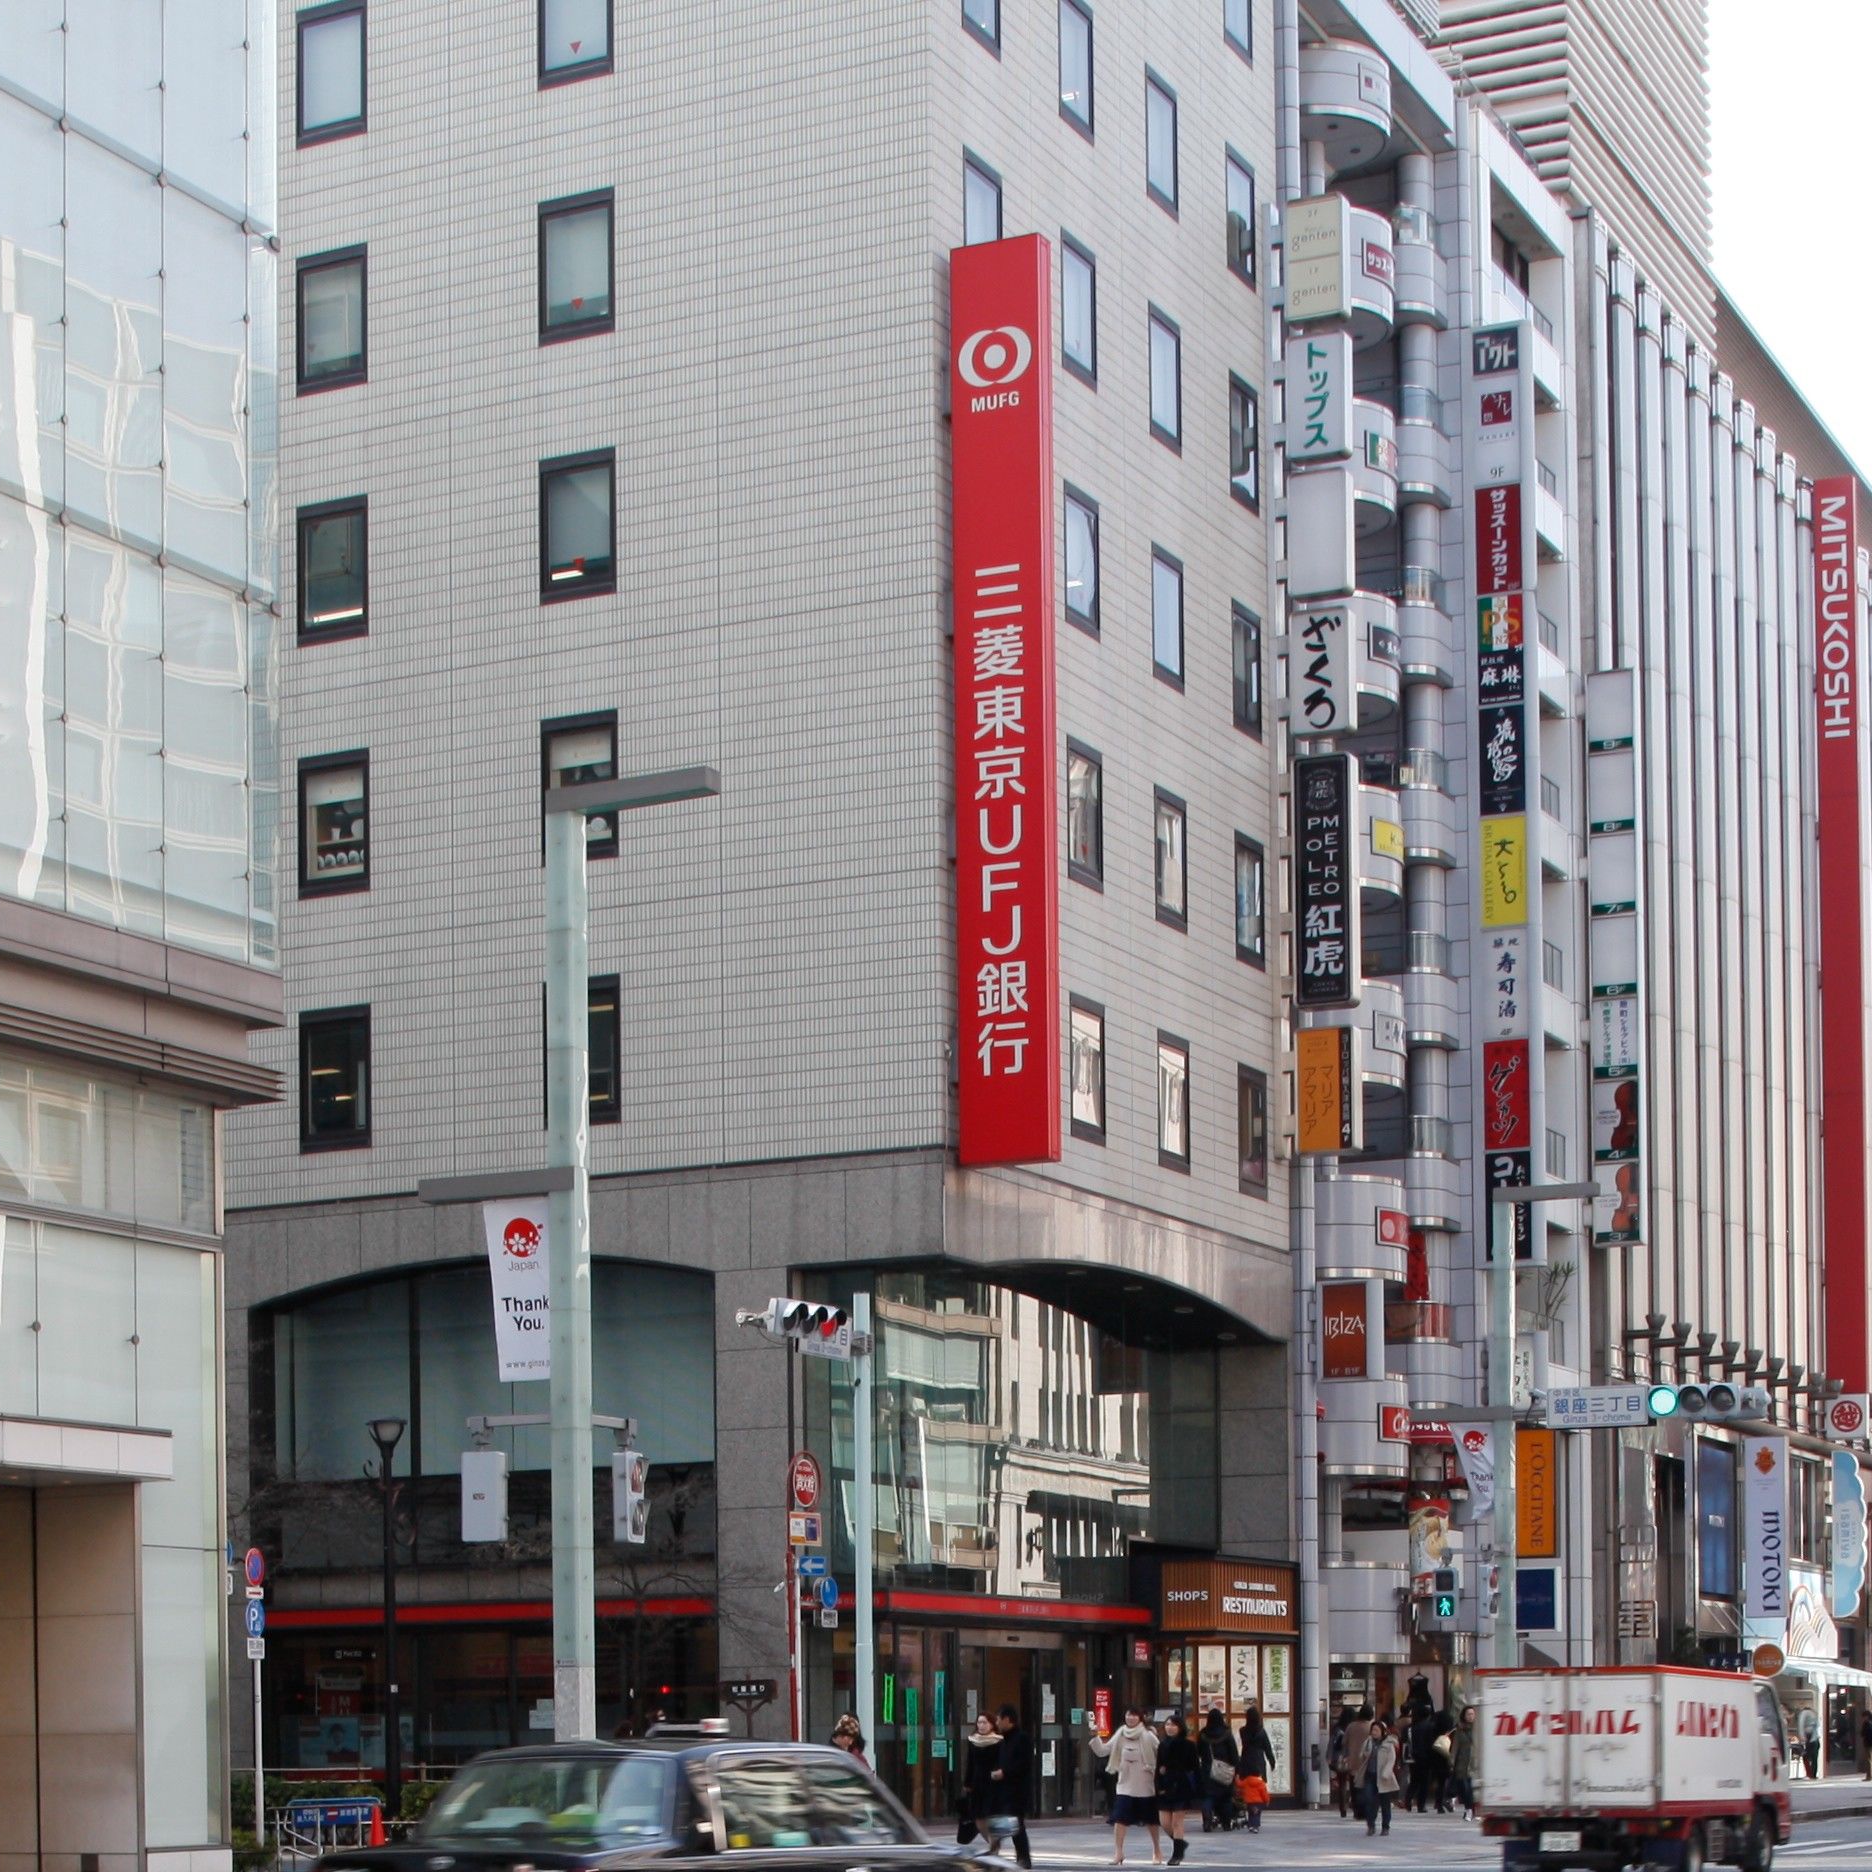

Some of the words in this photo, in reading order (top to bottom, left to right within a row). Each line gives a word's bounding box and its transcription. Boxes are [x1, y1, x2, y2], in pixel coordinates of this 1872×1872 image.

[1292, 283, 1337, 305] genten
[970, 390, 1020, 413] MUFG
[1304, 343, 1329, 449] トップス
[1489, 466, 1504, 478] 9F
[1489, 488, 1509, 591] サッスーンカット
[1820, 495, 1851, 740] MITSUKOSHI
[1302, 614, 1341, 730] ざくろ
[972, 563, 1030, 1075] 三菱東京UFJ銀行
[1306, 817, 1323, 896] POLE
[1323, 815, 1340, 895] METRO
[1303, 904, 1345, 978] 紅虎
[500, 1294, 550, 1313] Thank
[512, 1315, 546, 1332] You.
[1324, 1310, 1366, 1339] IBIZA
[1552, 1395, 1643, 1416] 銀座三丁目
[1528, 1441, 1545, 1549] L'OCCITANE
[1167, 1590, 1208, 1602] SHOPS
[1221, 1596, 1288, 1617] RESTAURANTS
